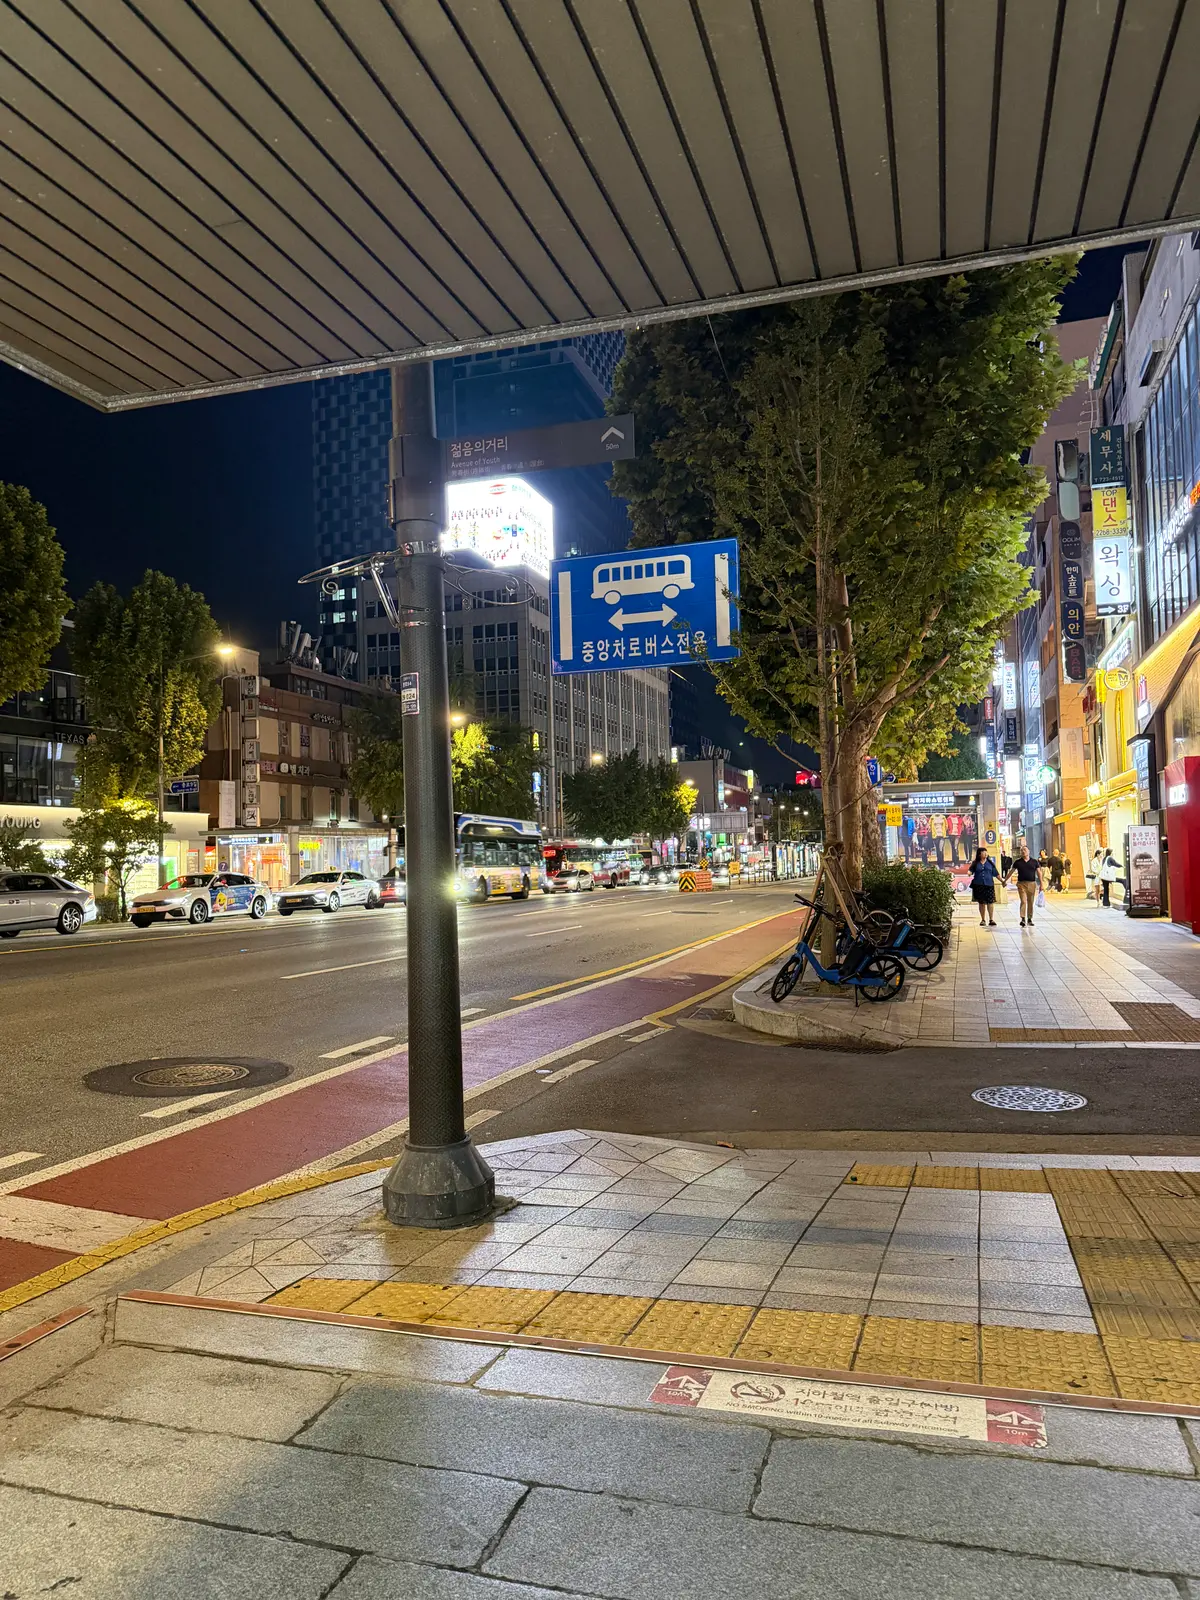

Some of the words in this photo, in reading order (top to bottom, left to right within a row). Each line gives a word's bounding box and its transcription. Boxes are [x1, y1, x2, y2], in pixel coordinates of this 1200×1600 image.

[450, 436, 508, 458] 젊음의거리
[605, 443, 620, 451] 50m
[1099, 429, 1113, 474] 세무사
[451, 460, 474, 469] Avenue
[482, 456, 501, 465] Youth
[1101, 489, 1117, 497] TOP
[1103, 497, 1118, 528] 댄스
[1100, 543, 1123, 597] 왁싱
[1117, 604, 1130, 614] 3F
[1068, 609, 1081, 635] 의안
[581, 630, 707, 663] 중앙차로버스전용
[1070, 649, 1081, 676] BAR
[55, 732, 85, 745] TEXAS
[0, 815, 41, 829] YOUNG
[741, 1403, 784, 1413] SMOKING
[786, 1409, 813, 1417] within
[874, 1419, 910, 1428] Subway
[911, 1422, 959, 1433] Entrances
[1006, 1428, 1029, 1437] 10m
